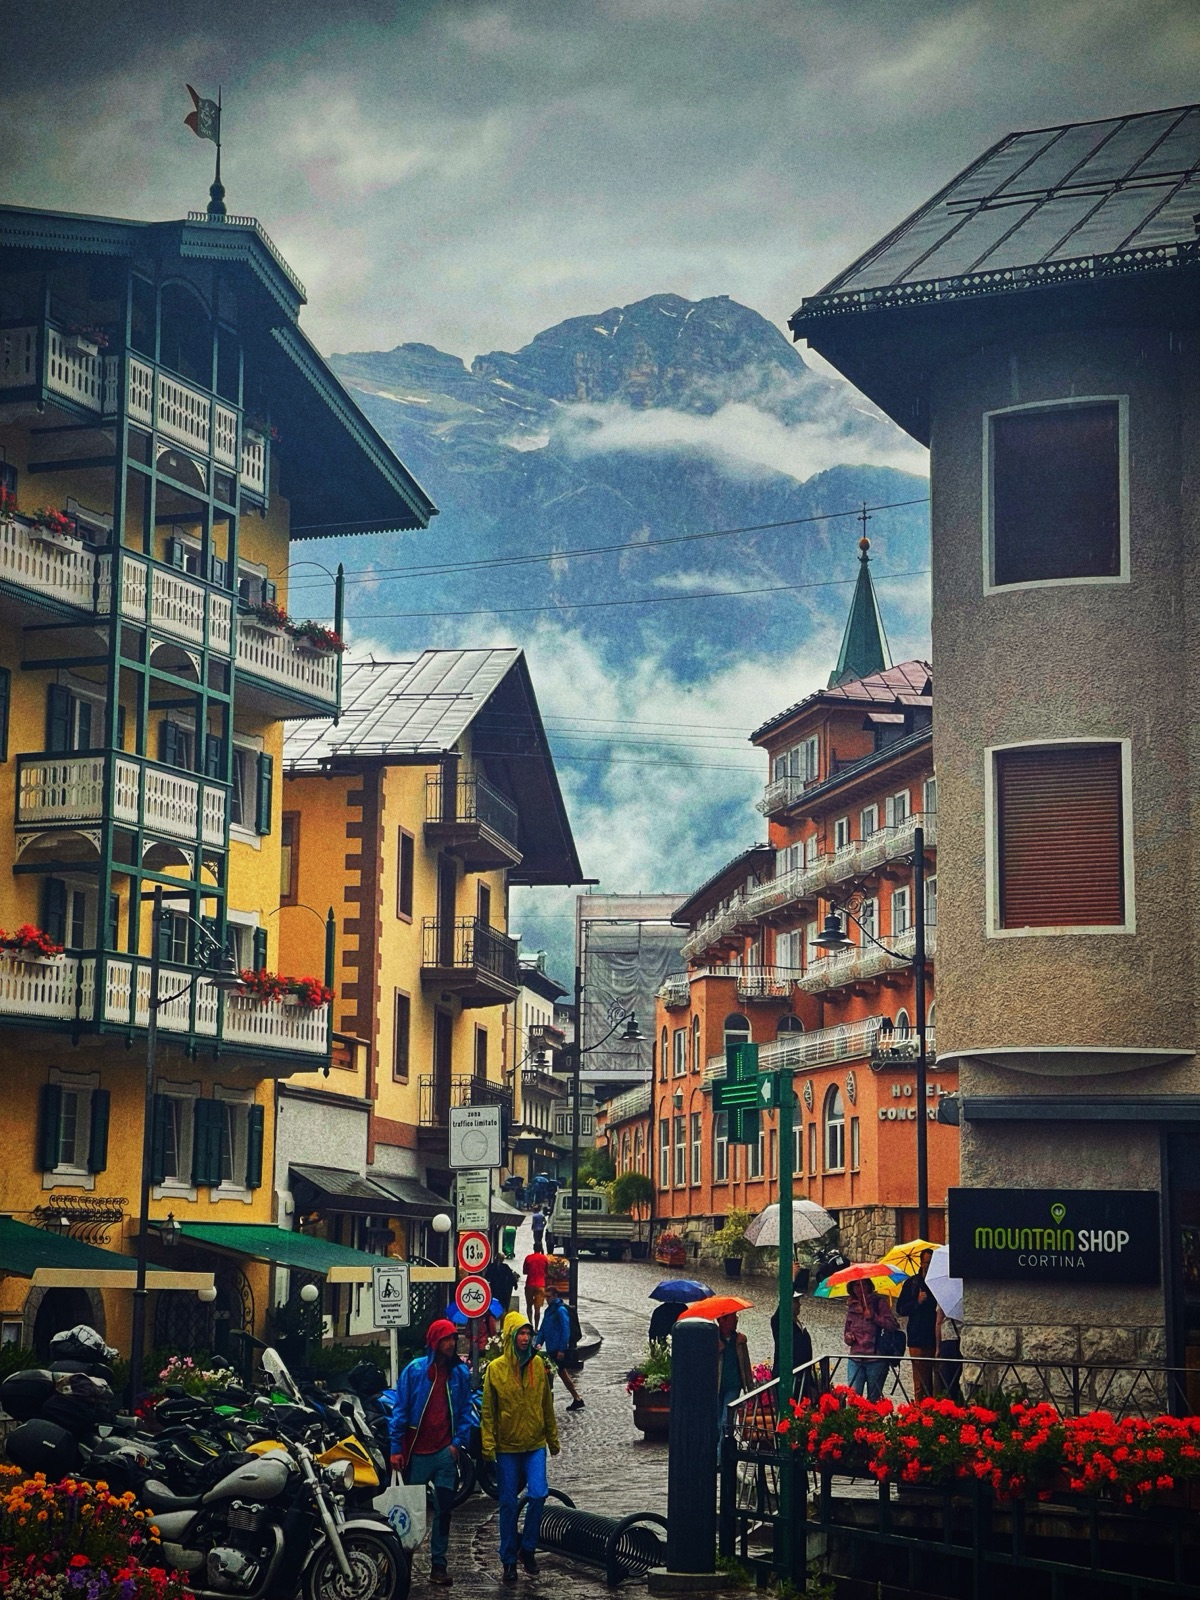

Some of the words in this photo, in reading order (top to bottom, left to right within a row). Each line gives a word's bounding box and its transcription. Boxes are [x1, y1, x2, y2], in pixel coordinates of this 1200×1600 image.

[891, 1084, 944, 1097] HOEL
[452, 1120, 474, 1128] traffico
[474, 1119, 498, 1127] limitato
[975, 1227, 1075, 1251] MOUNTAIN
[1078, 1229, 1130, 1252] SHOP
[1018, 1254, 1086, 1268] CORTINA
